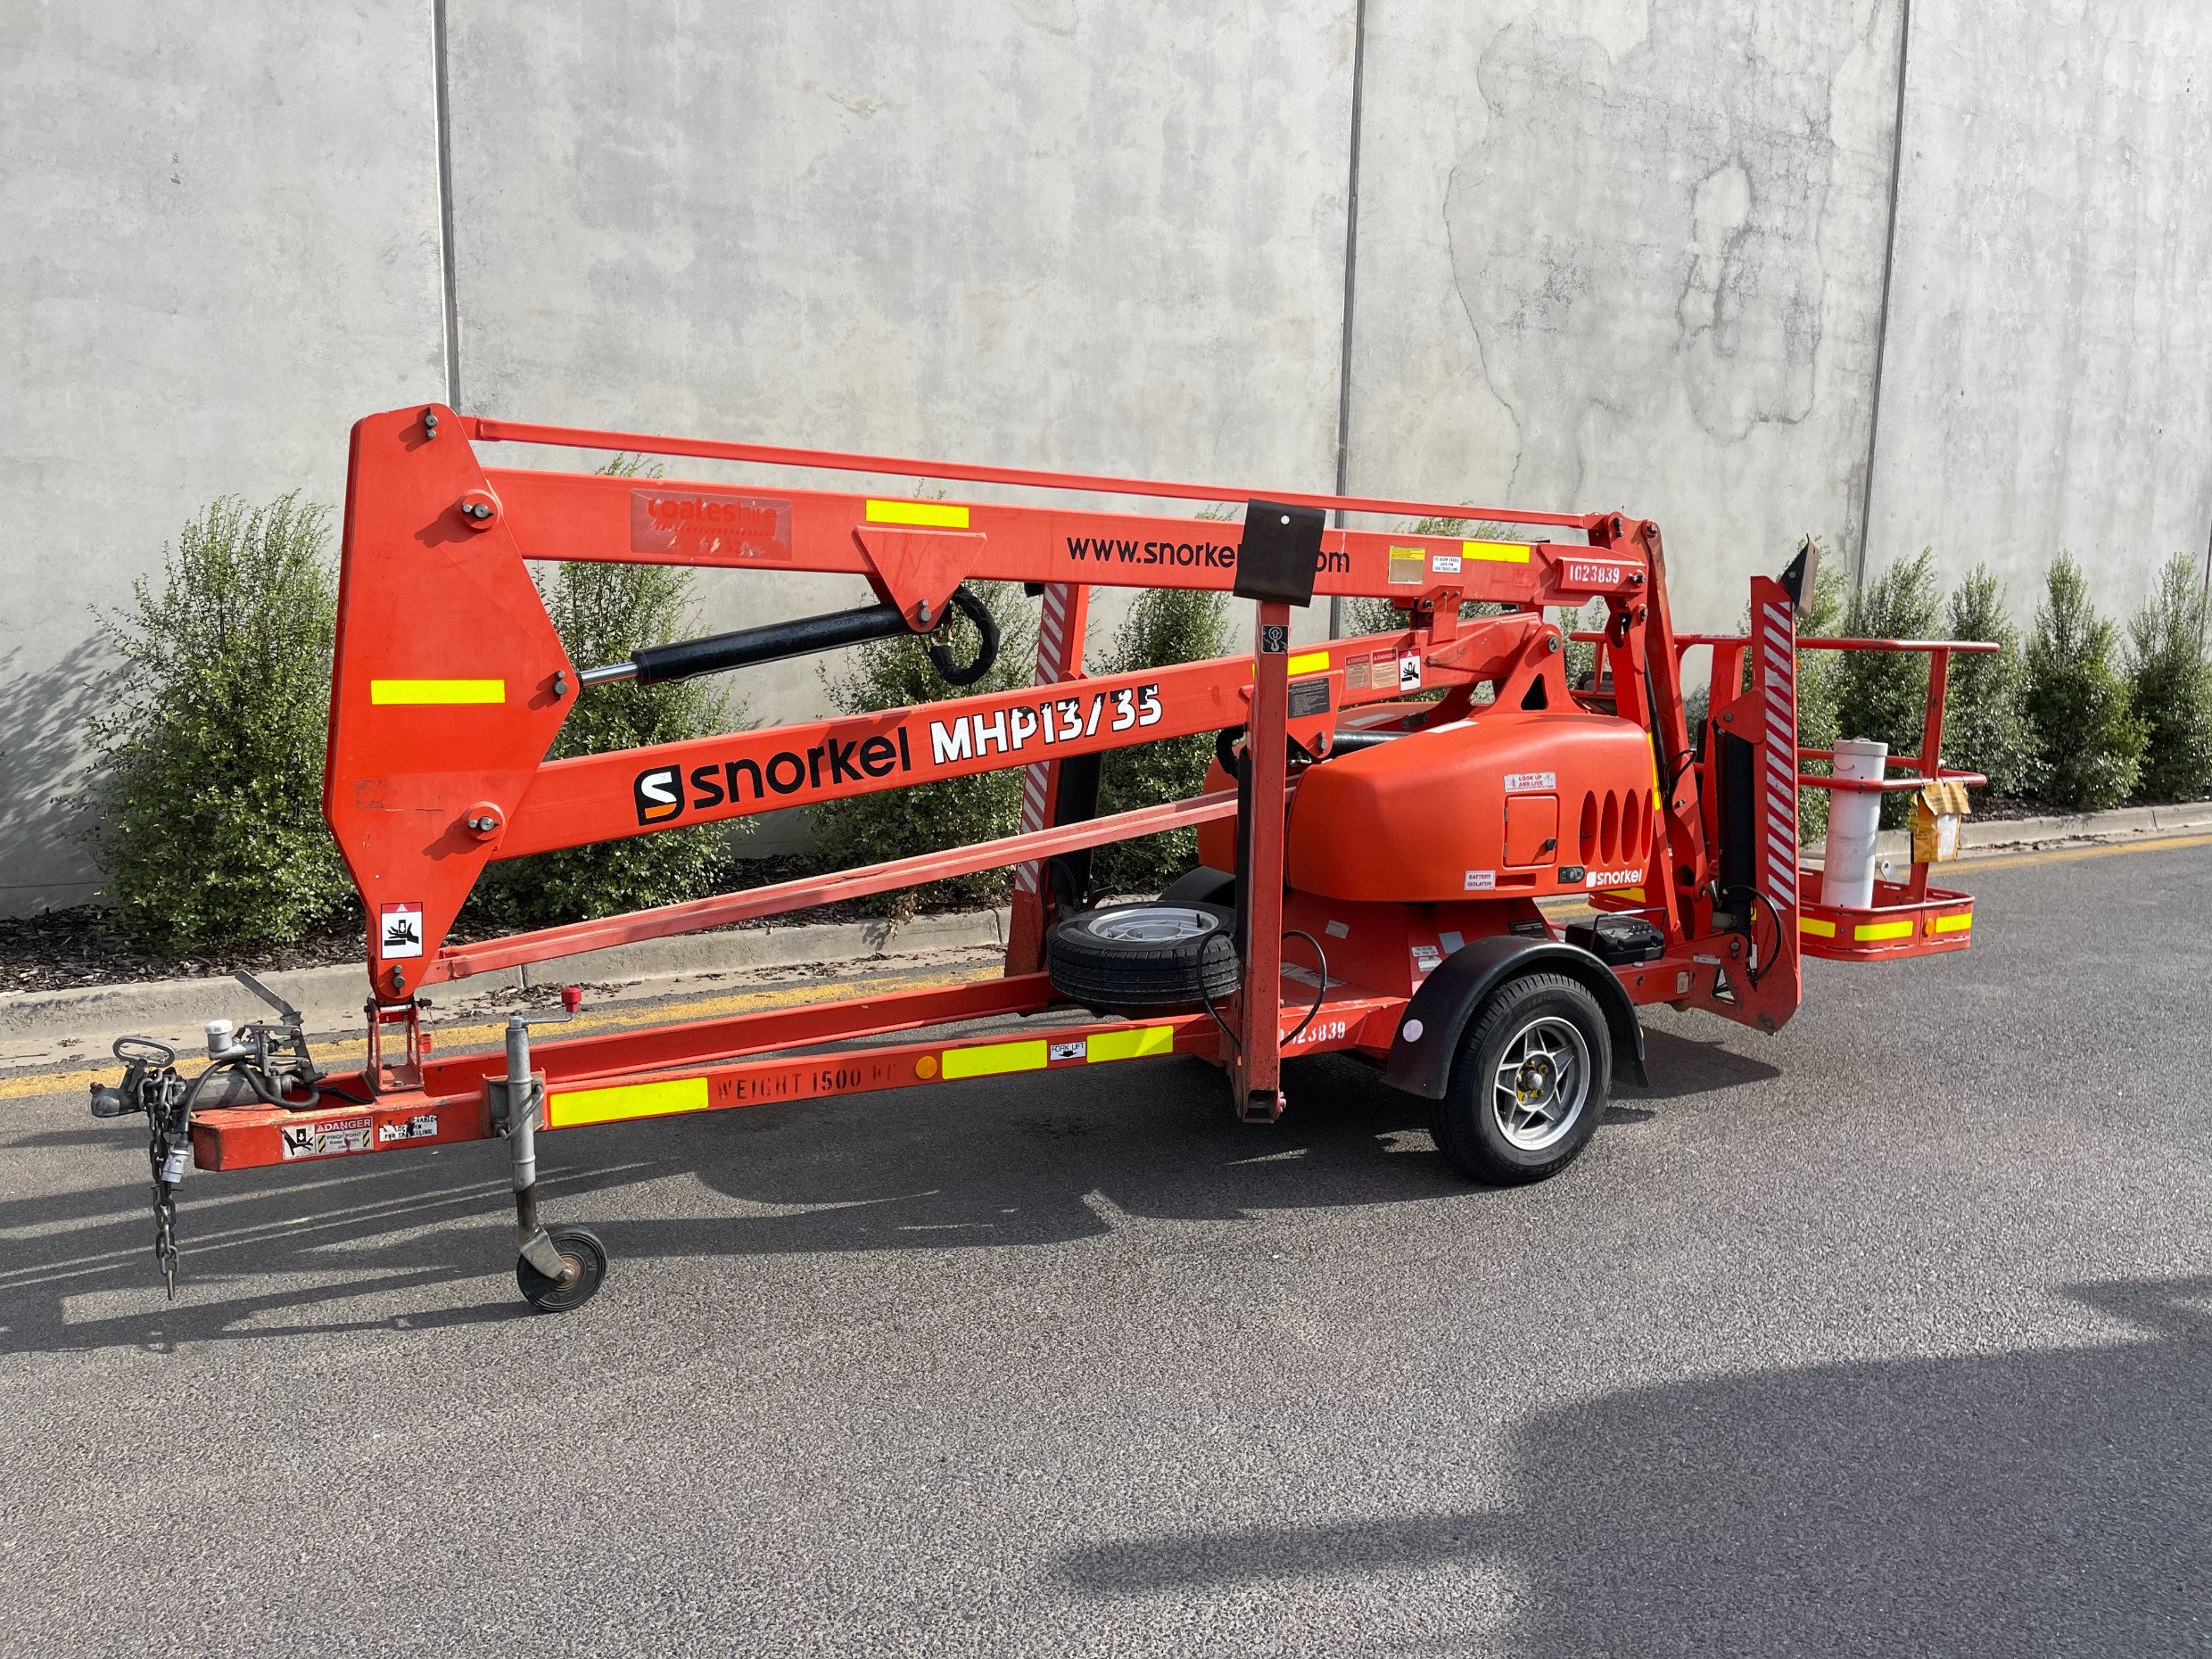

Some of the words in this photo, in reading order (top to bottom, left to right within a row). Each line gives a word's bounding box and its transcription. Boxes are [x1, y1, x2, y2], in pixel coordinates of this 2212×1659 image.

[1570, 565, 1620, 584] 1023839
[691, 727, 911, 805] snorkel
[929, 684, 1163, 765] MHP13/35
[1597, 868, 1643, 886] snorkel
[1051, 1044, 1069, 1052] FORK
[1071, 1042, 1085, 1051] LIFT
[716, 1073, 803, 1101] WEIGHT
[813, 1068, 862, 1093] 1500
[324, 1118, 371, 1132] DANGER
